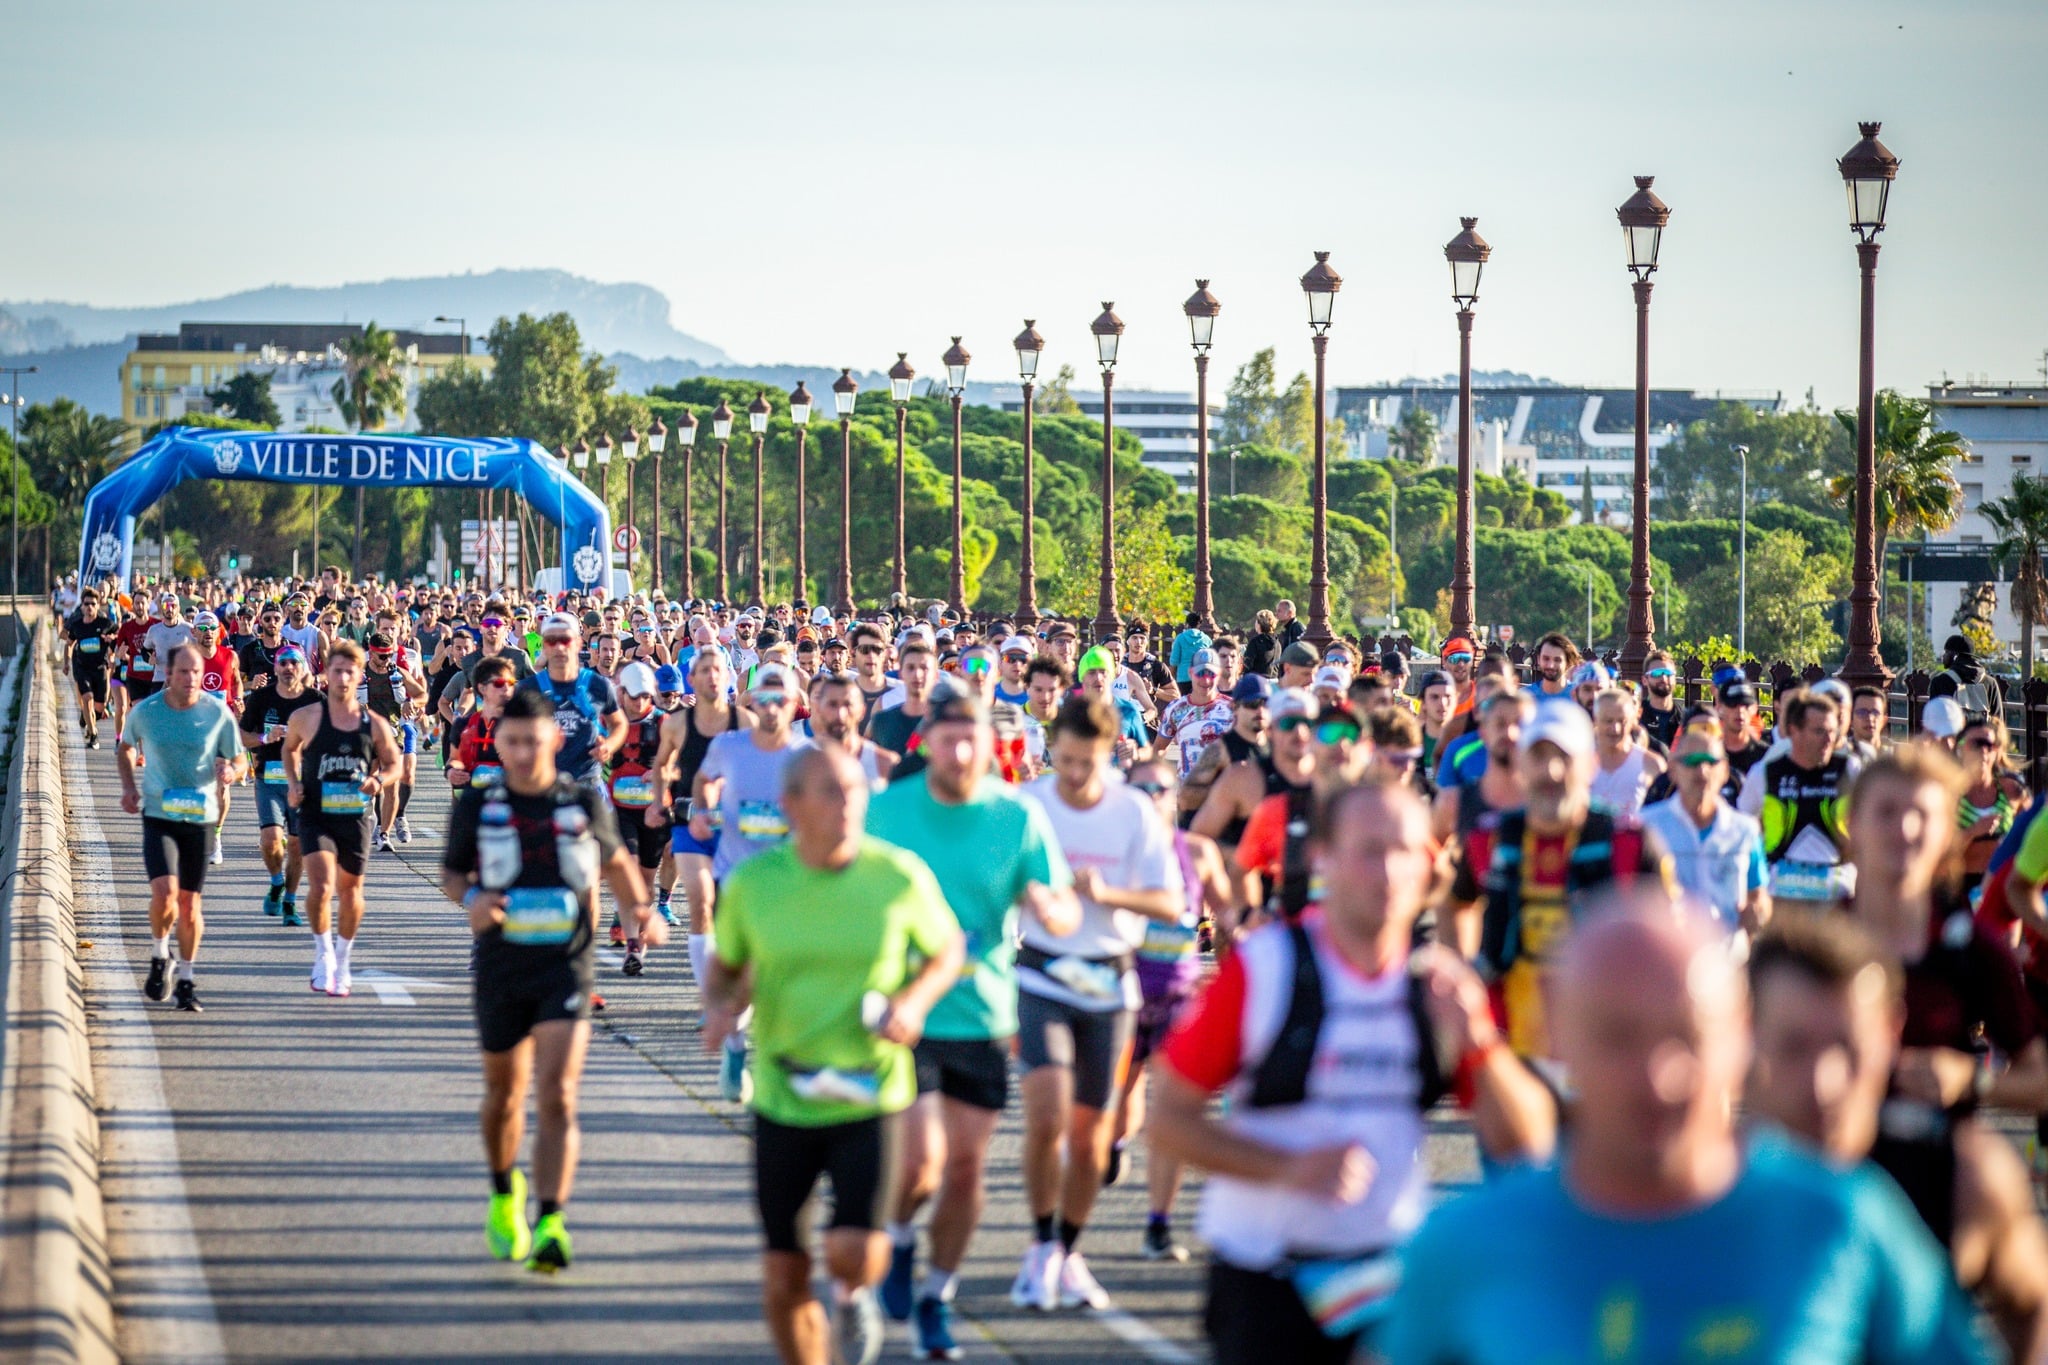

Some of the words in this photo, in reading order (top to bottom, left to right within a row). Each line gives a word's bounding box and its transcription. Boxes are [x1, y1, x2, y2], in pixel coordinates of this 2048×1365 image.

[249, 441, 339, 478] VILLE
[350, 444, 396, 480] DE
[405, 446, 490, 482] NICE
